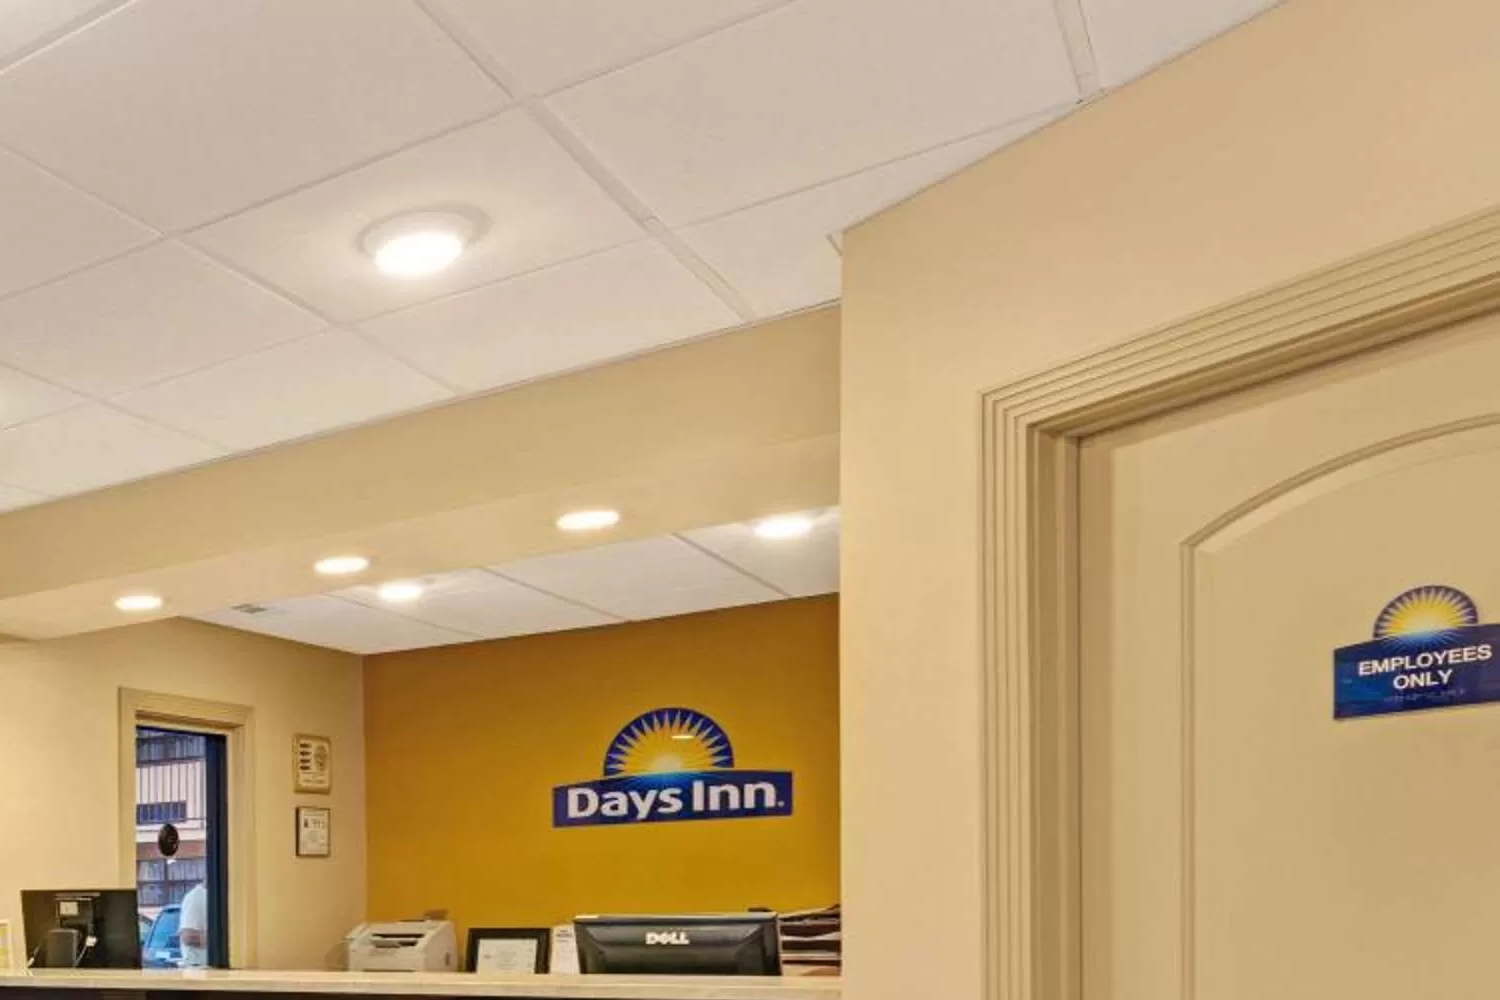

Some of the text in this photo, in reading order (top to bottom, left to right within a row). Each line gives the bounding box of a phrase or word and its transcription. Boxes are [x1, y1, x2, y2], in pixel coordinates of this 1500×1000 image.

[1358, 644, 1493, 677] EMPLOYEES
[1392, 669, 1453, 690] ONLY
[566, 780, 777, 820] Days Inn
[645, 931, 690, 945] DELL
